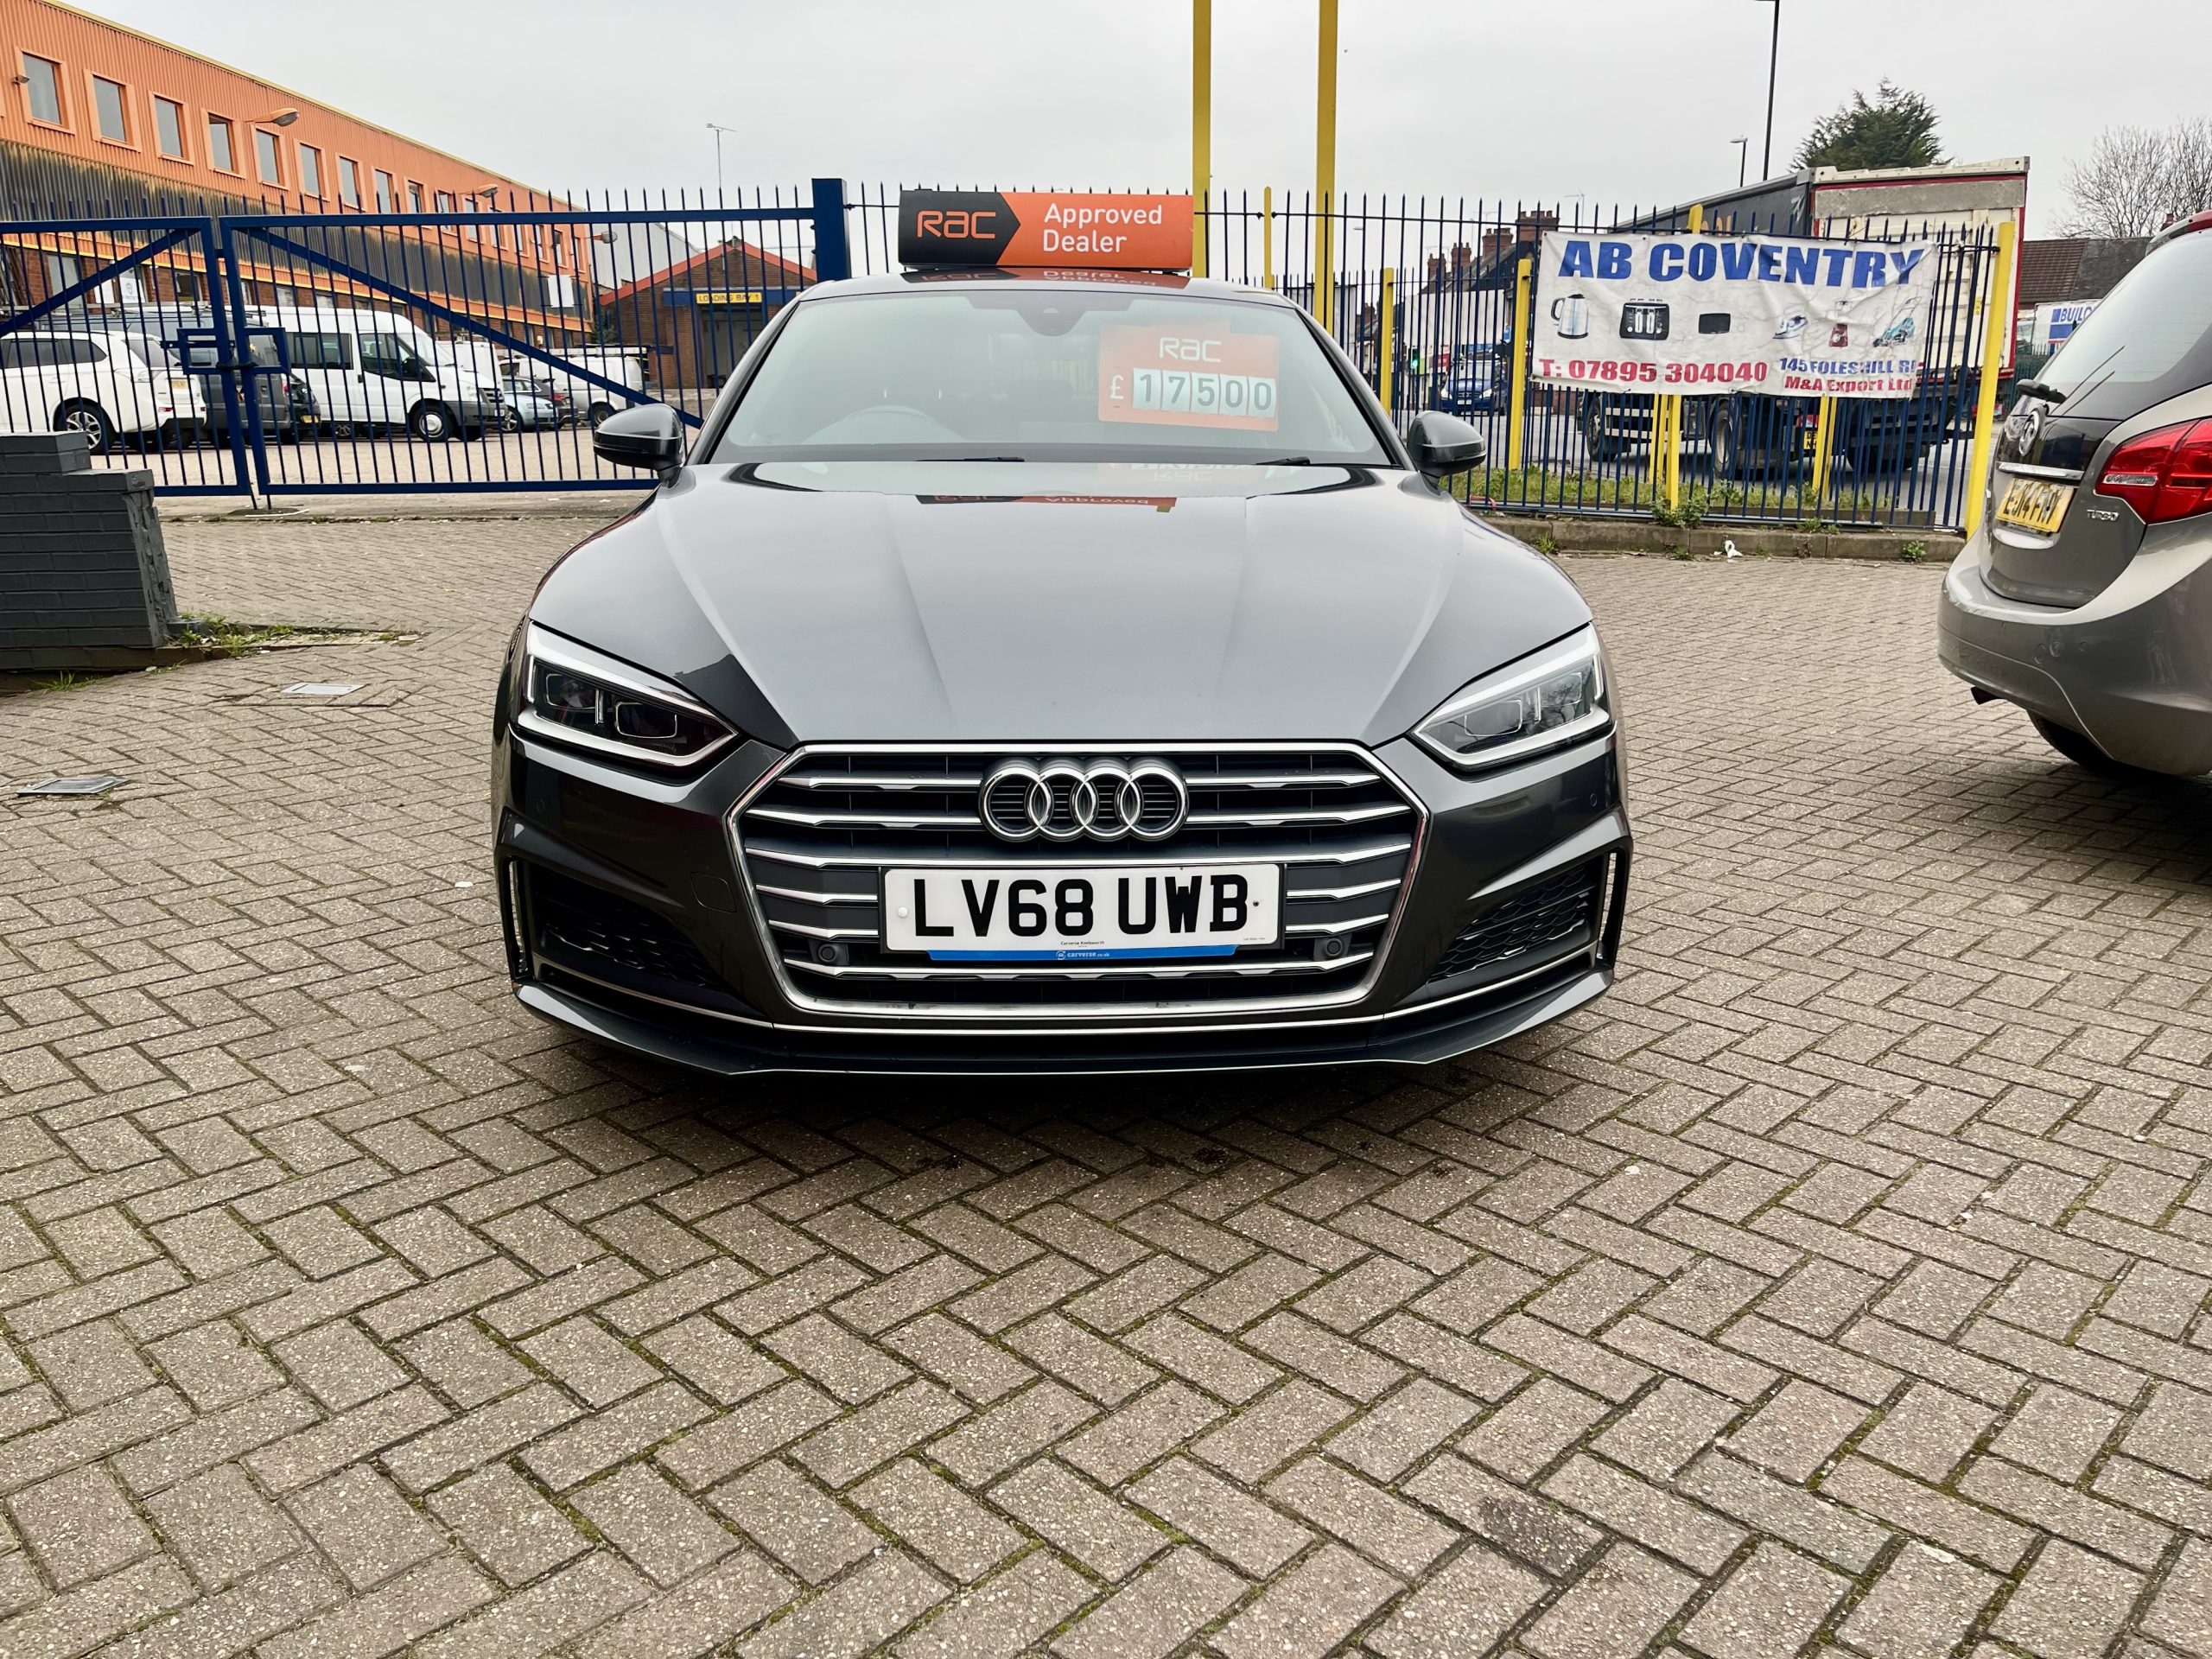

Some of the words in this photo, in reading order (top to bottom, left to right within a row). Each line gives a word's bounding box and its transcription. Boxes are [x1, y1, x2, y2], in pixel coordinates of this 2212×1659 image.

[1044, 203, 1162, 229] Approved
[1043, 228, 1127, 253] Dealer
[1558, 240, 1632, 279] AB
[1649, 242, 1924, 288] COVENTRY
[1539, 359, 1562, 378] T:
[1568, 359, 1656, 381] 07895
[1664, 361, 1768, 384] 304040
[1779, 357, 1808, 372] 145
[1109, 374, 1124, 399] £
[1140, 374, 1272, 410] 17500
[1784, 376, 1822, 391] M&A
[914, 878, 1094, 937] LV68
[1118, 874, 1248, 935] UWB
